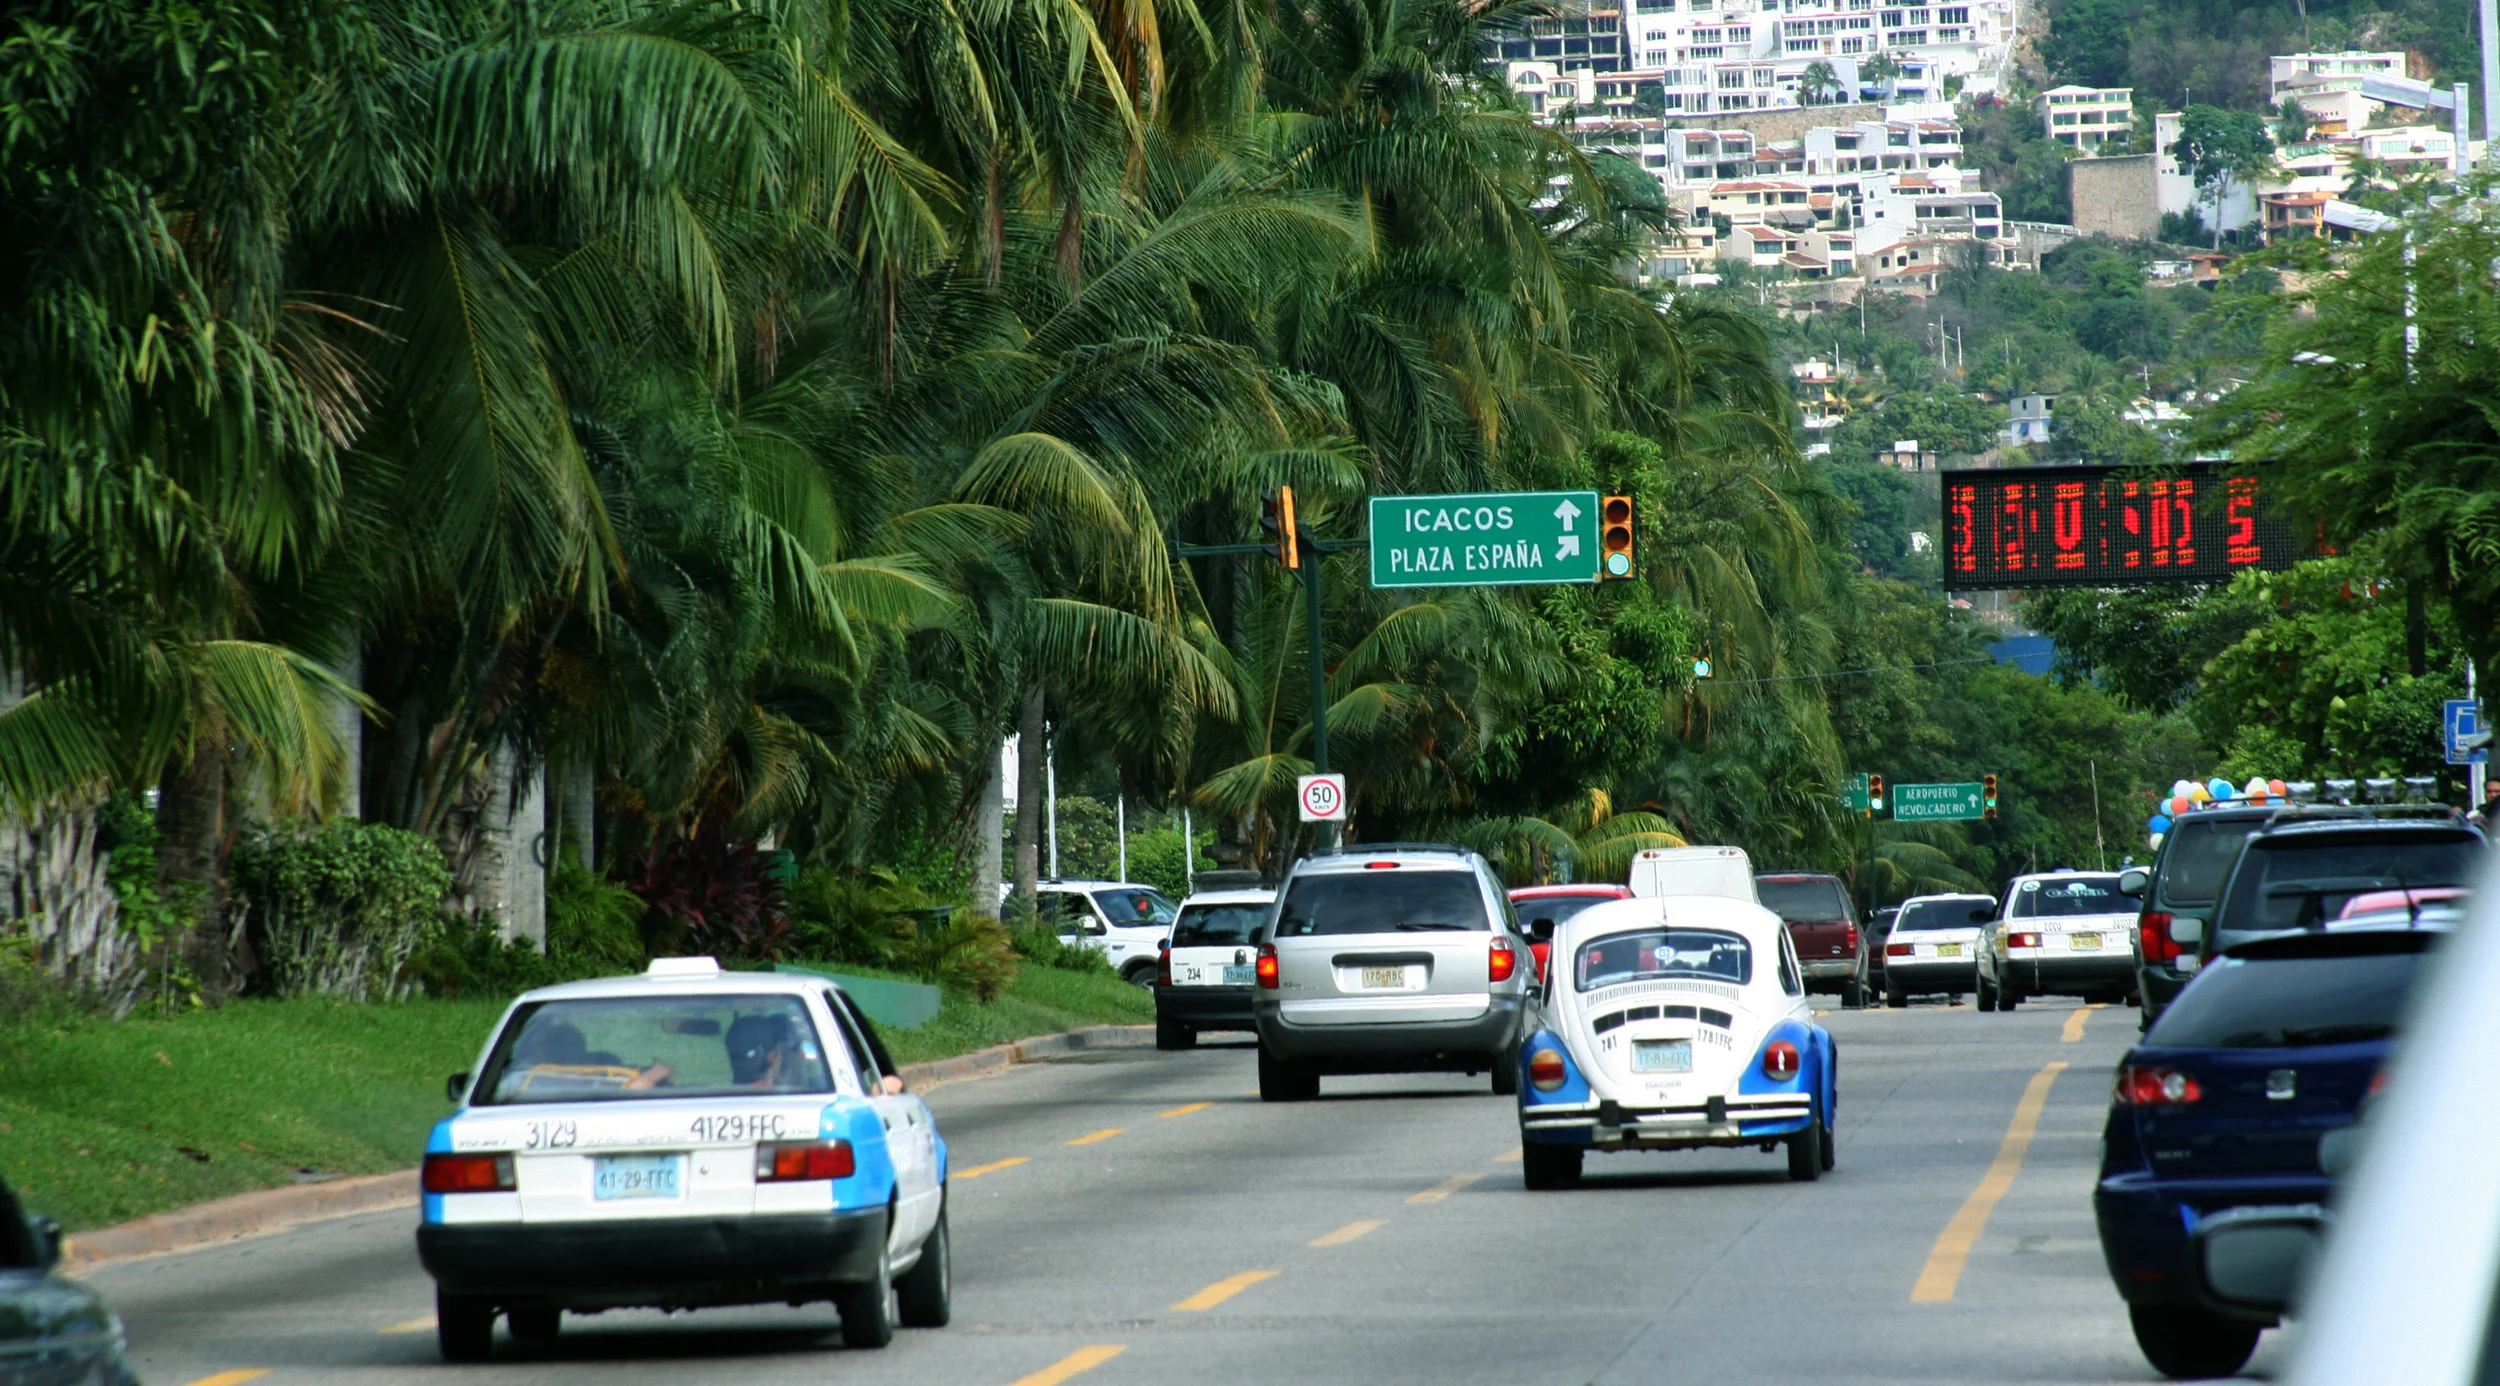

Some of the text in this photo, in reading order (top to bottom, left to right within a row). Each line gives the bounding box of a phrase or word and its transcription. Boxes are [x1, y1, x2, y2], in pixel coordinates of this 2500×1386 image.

[1405, 506, 1514, 532] ICACOS
[1390, 539, 1543, 573] PLAZA ESPAÑA
[1312, 786, 1332, 804] 50
[1898, 803, 1966, 816] REVOLCADERO
[1187, 967, 1201, 981] 234
[1601, 1033, 1617, 1053] 781
[524, 1118, 578, 1149] 3129
[600, 1168, 675, 1190] 41-29-FFC
